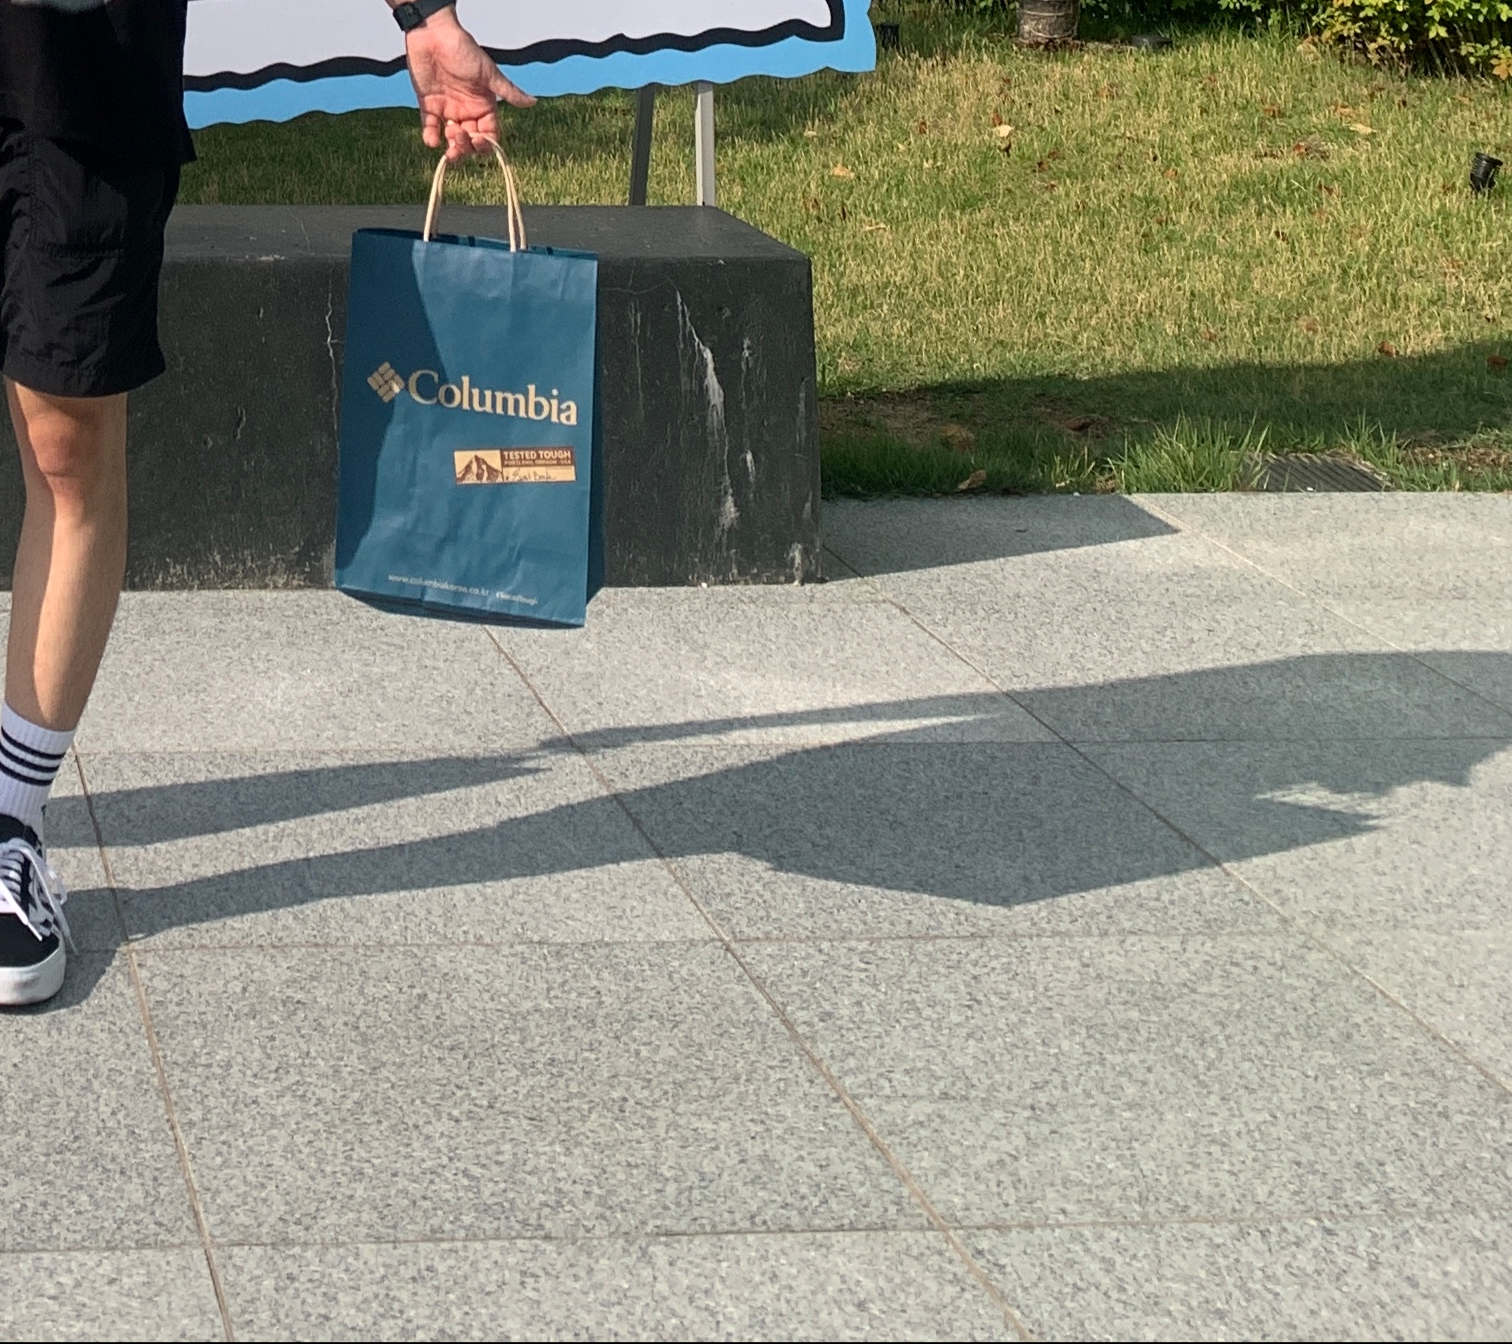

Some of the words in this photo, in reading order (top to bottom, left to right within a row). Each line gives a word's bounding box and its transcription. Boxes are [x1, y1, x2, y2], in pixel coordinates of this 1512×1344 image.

[408, 368, 578, 426] Columbia
[503, 450, 537, 460] TESTED
[538, 449, 572, 460] TOUGH
